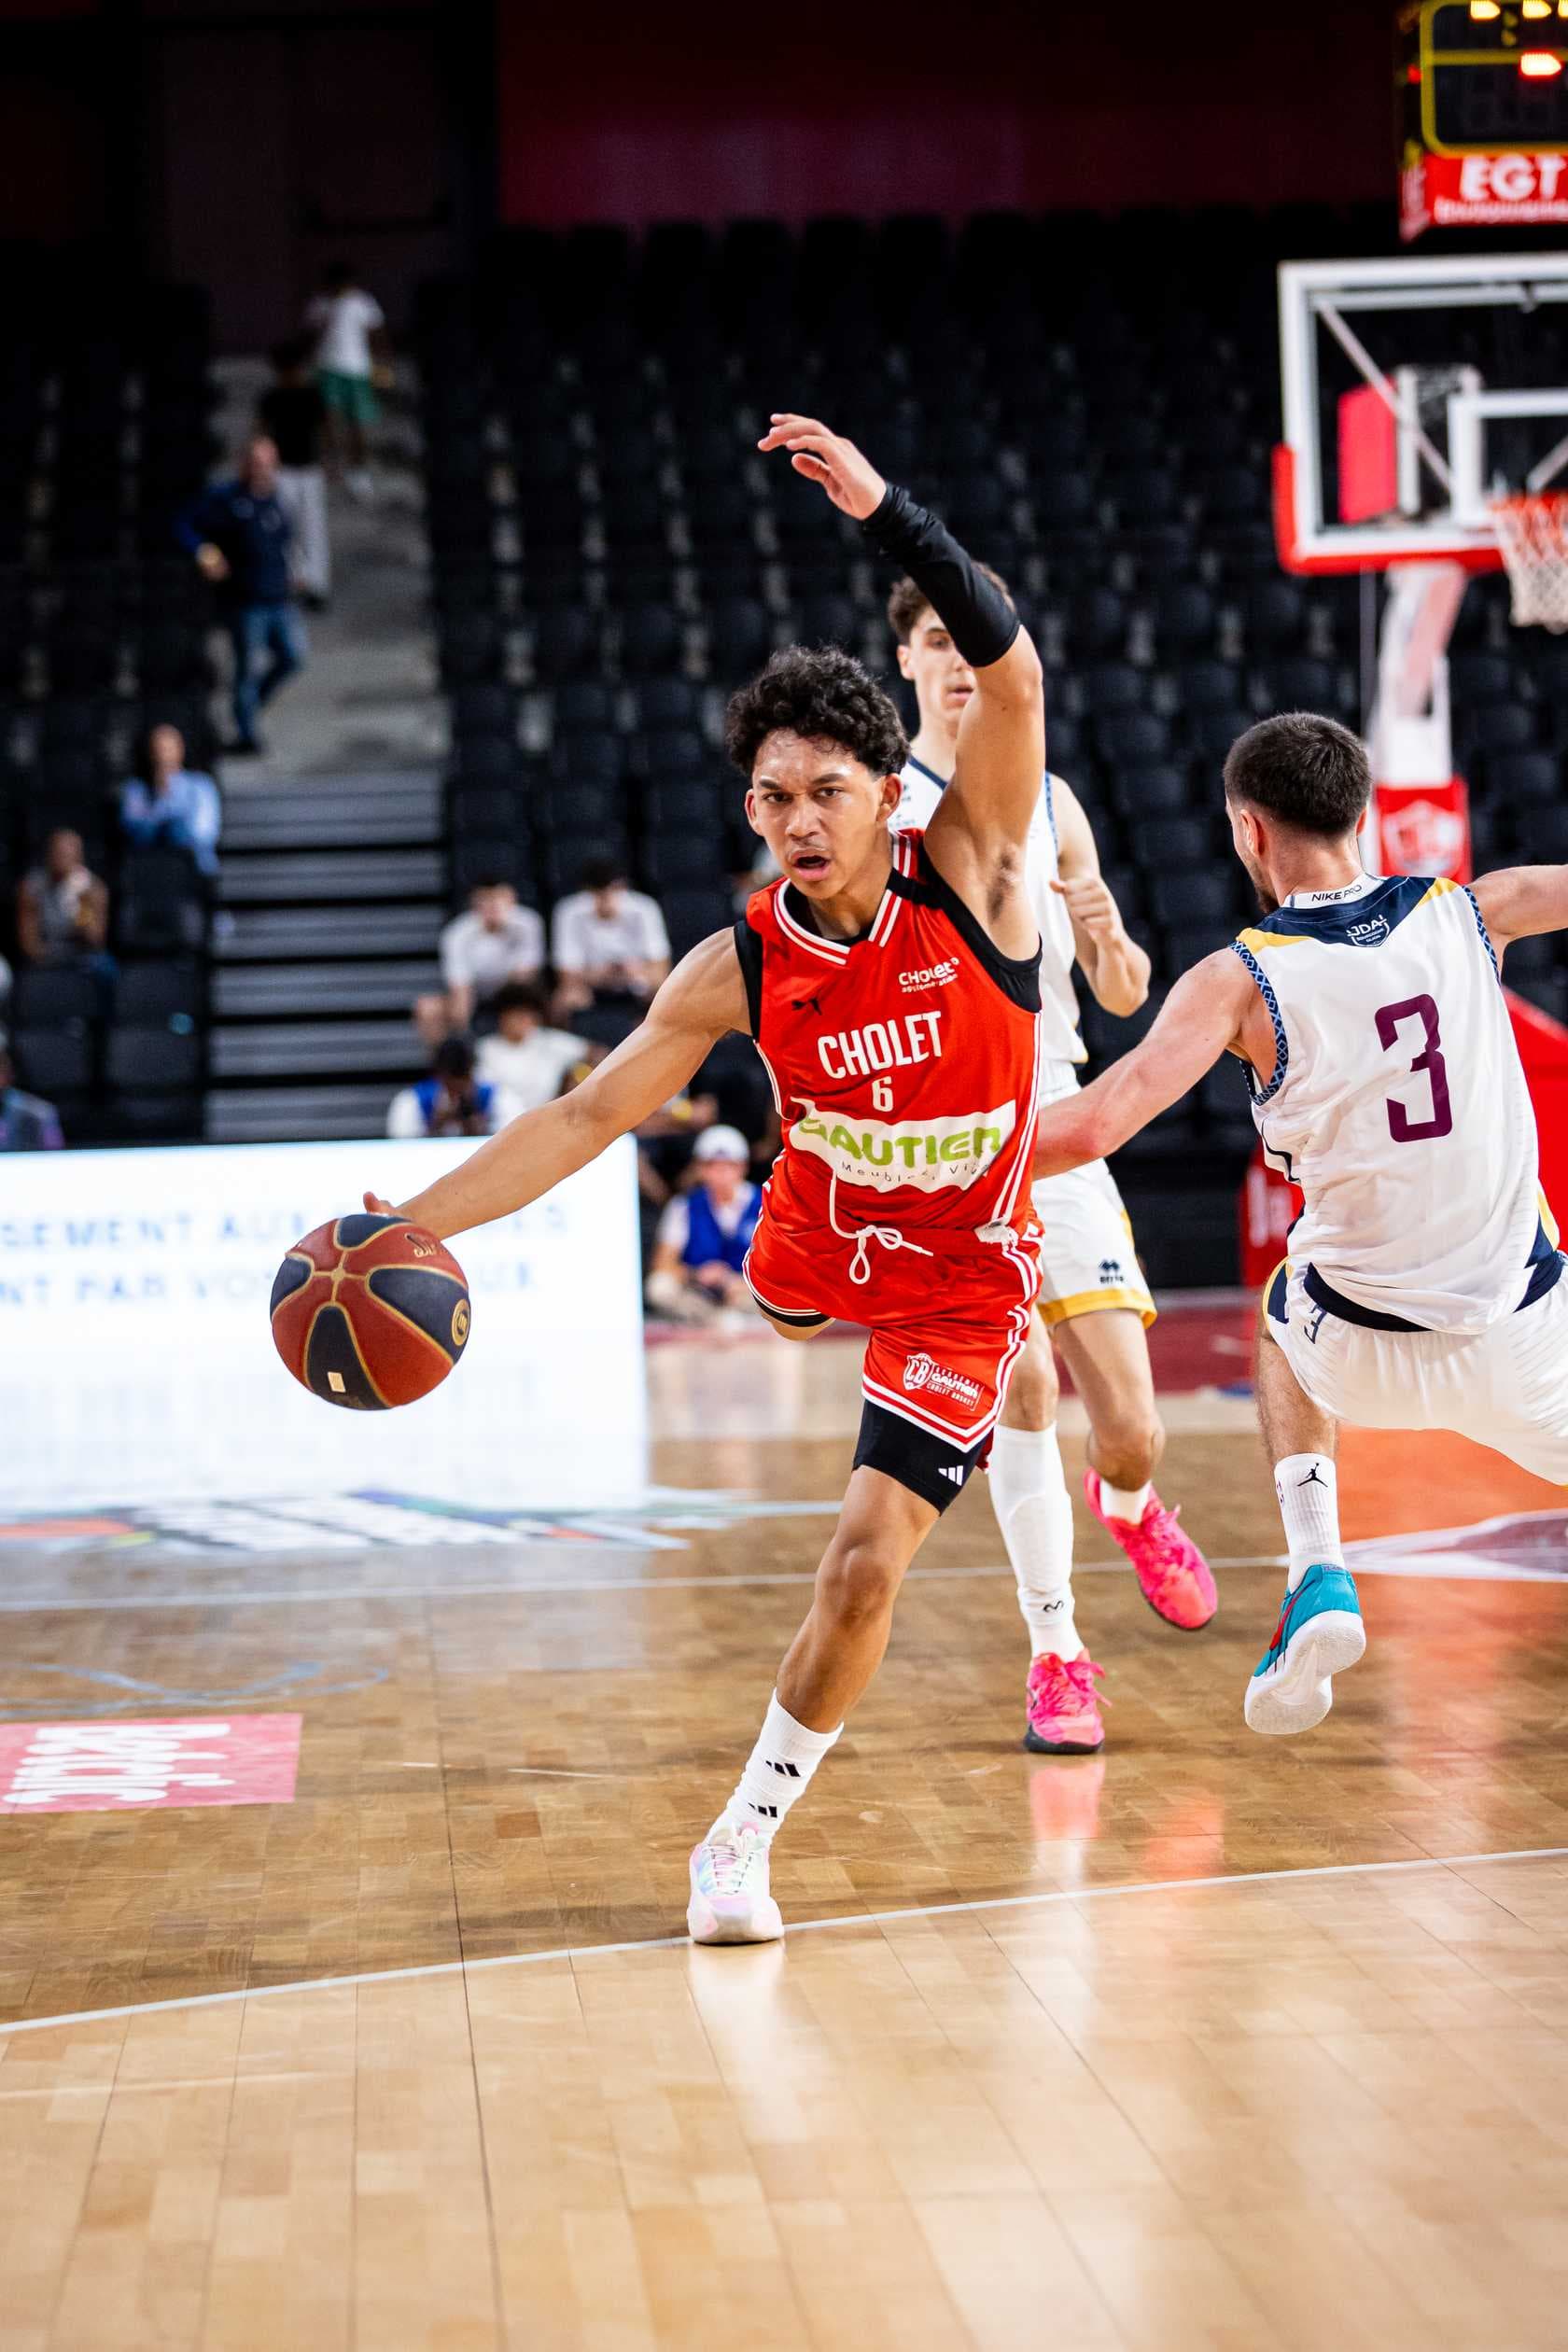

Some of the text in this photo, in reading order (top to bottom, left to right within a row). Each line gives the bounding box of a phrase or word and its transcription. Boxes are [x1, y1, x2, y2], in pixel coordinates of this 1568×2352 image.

[1460, 153, 1567, 201] EGT
[1311, 892, 1341, 902] NIKE
[818, 1011, 942, 1079] CHOLET
[1375, 994, 1452, 1142] 3
[872, 1076, 893, 1112] 6
[1305, 1304, 1326, 1344] 3
[905, 1359, 930, 1385] CB
